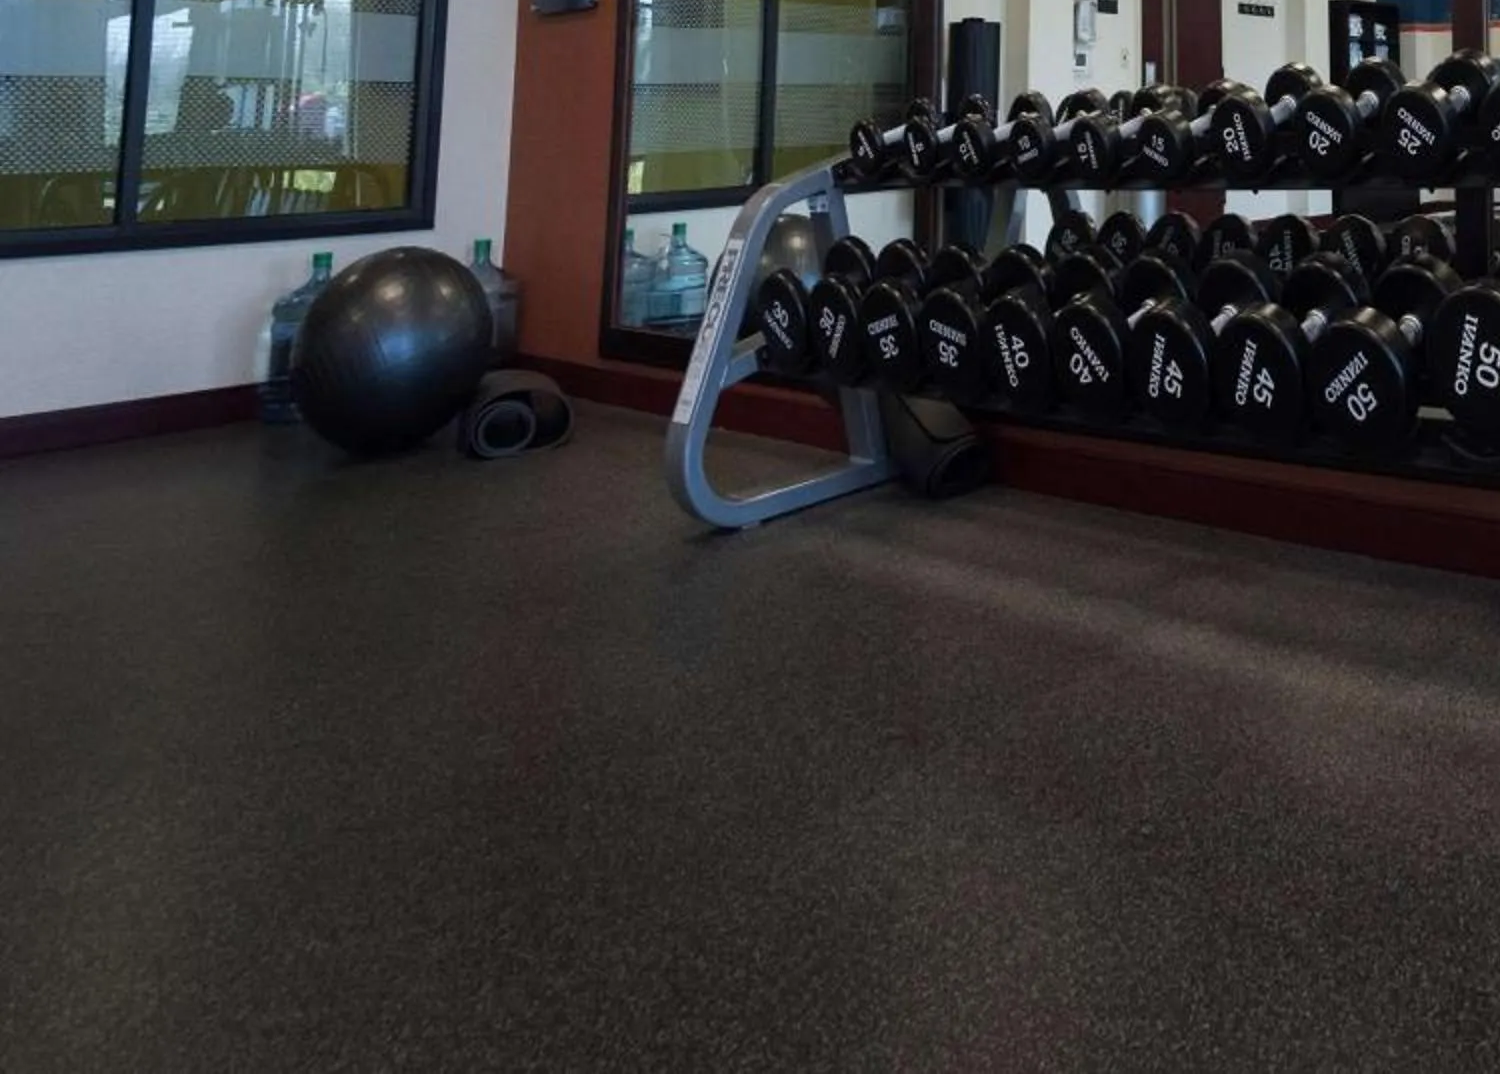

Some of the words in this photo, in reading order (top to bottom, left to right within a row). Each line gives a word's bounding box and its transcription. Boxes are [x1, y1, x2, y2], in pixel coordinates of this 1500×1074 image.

[1223, 127, 1239, 153] 20
[1309, 130, 1331, 155] 20
[1397, 128, 1421, 155] 25
[939, 340, 959, 367] 35
[1011, 335, 1029, 368] 40
[1070, 353, 1093, 383] 40
[1454, 313, 1479, 395] IVANKO
[1163, 359, 1184, 398] 45
[1253, 367, 1275, 409] 45
[1324, 350, 1369, 403] IVANKO
[1347, 383, 1378, 421] 50
